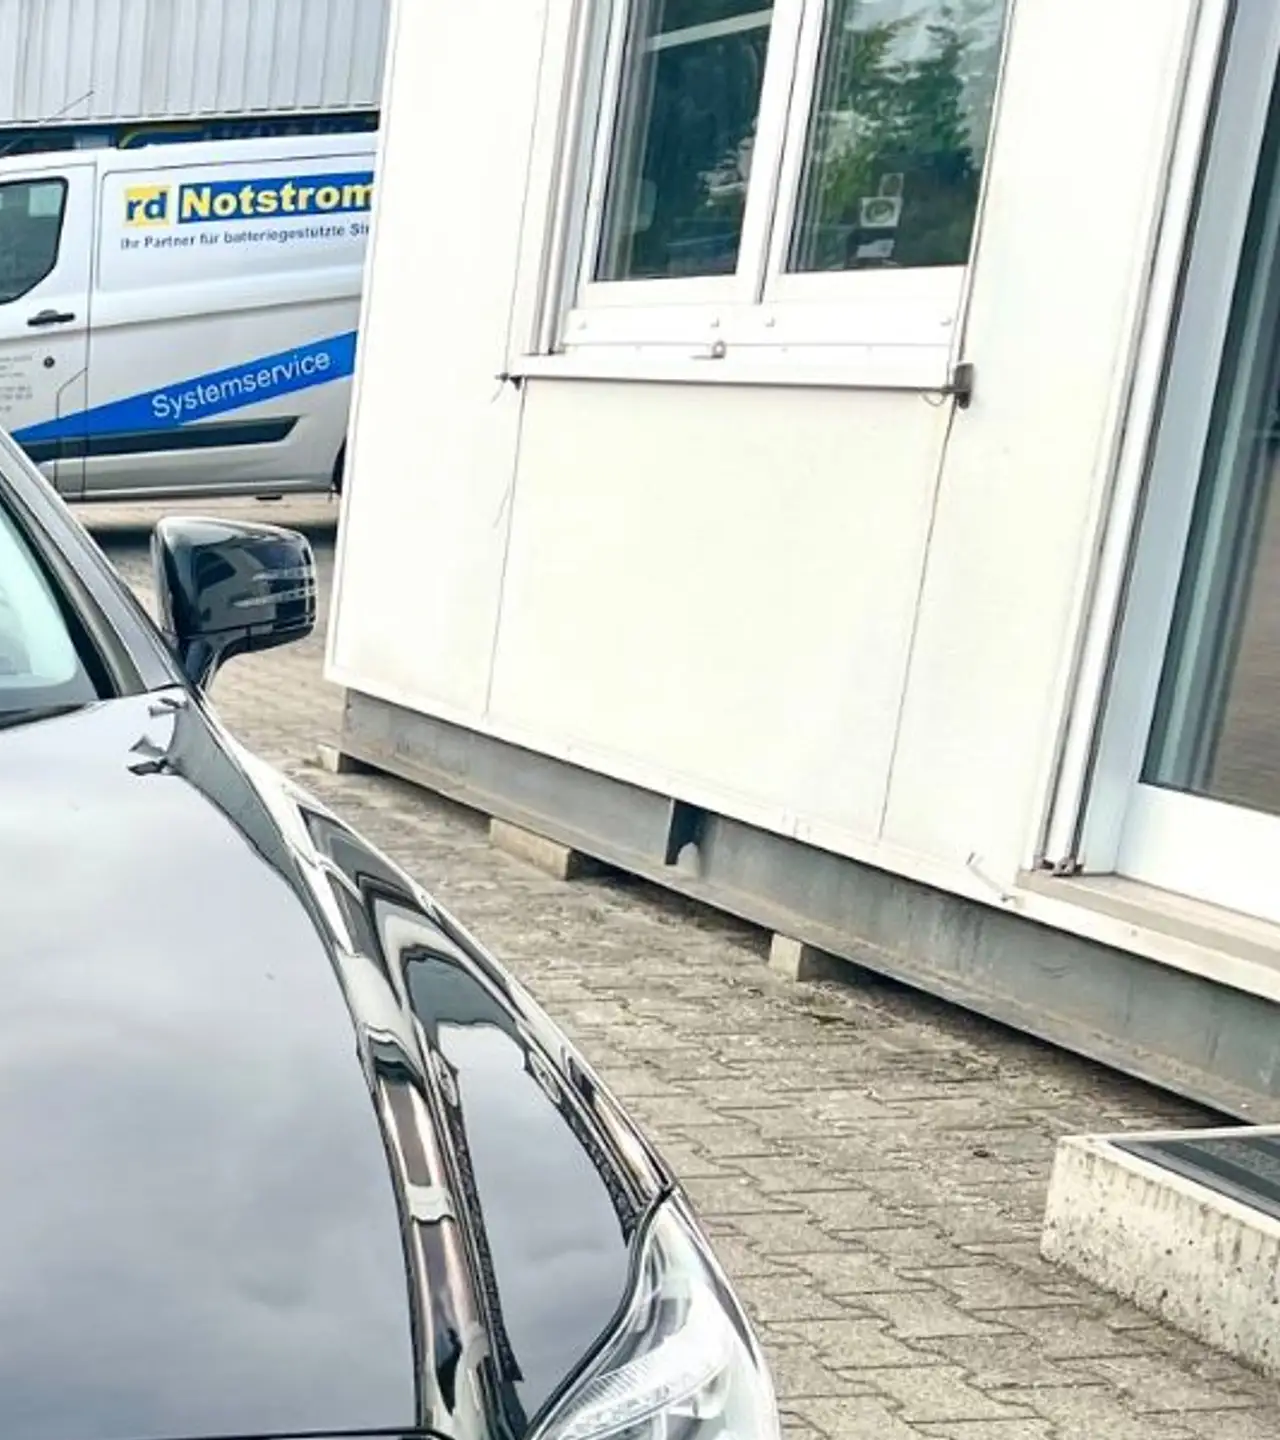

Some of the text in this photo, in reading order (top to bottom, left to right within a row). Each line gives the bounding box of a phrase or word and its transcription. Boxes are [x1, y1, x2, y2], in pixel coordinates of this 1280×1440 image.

[125, 180, 374, 222] rd Notstrom
[144, 235, 196, 249] Partner
[151, 351, 331, 419] Systemservice
